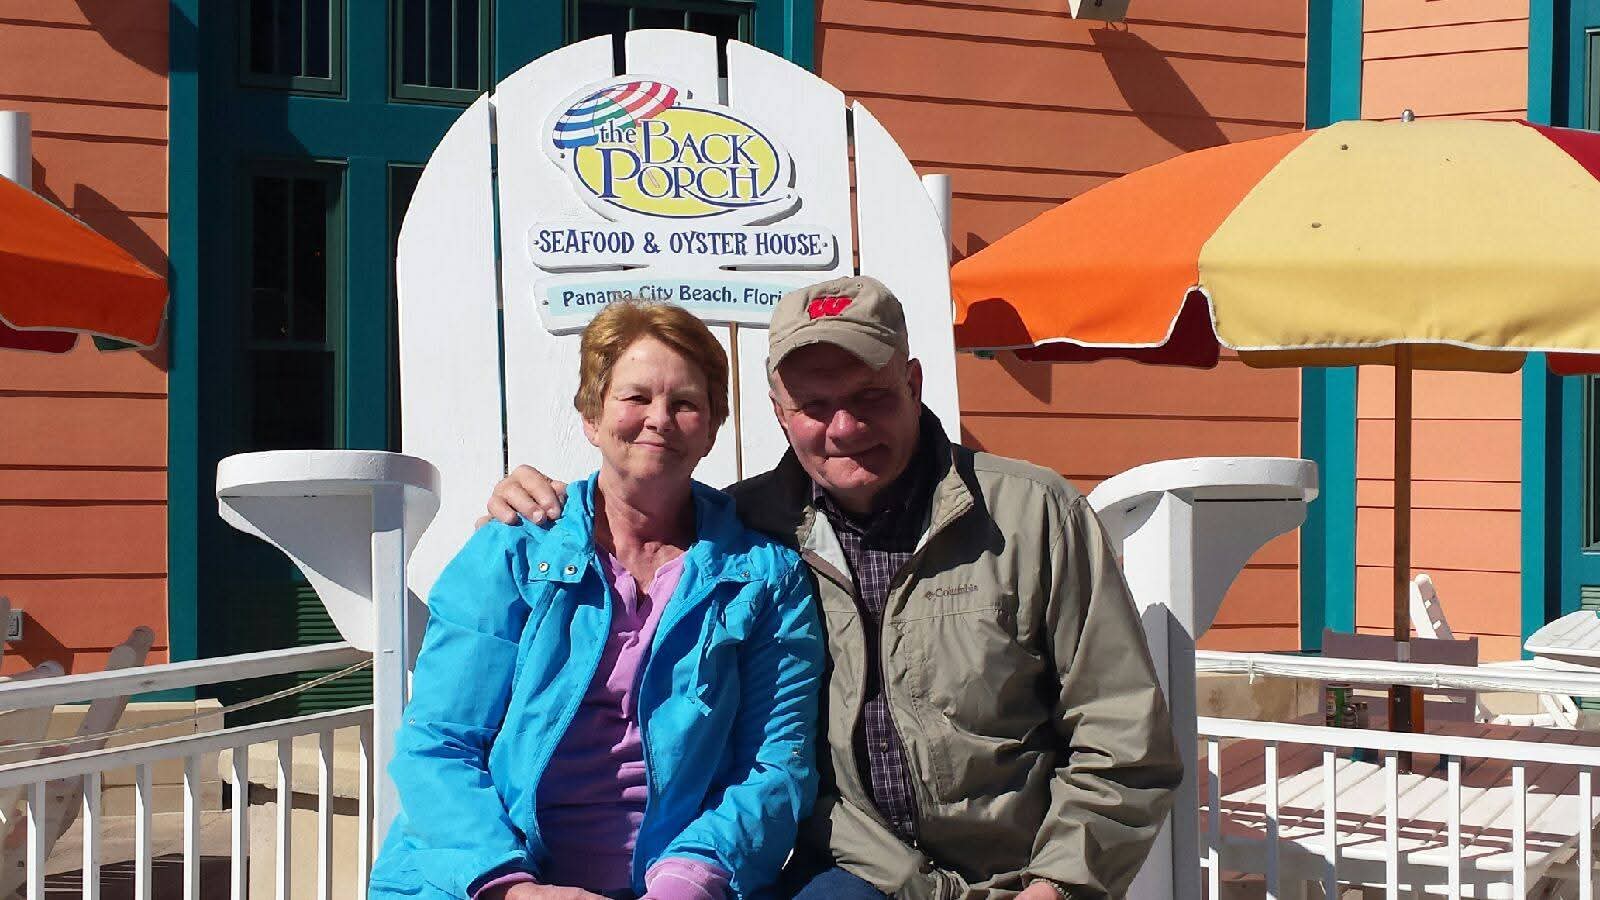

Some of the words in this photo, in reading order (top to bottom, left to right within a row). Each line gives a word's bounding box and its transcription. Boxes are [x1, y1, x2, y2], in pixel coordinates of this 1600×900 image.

[600, 120, 637, 143] the
[641, 120, 757, 165] BACK
[595, 147, 760, 199] PORCH
[539, 229, 635, 254] SEAFOOD
[643, 231, 661, 254] &
[669, 231, 748, 256] OYSTER
[754, 233, 821, 256] HOUSE
[563, 289, 632, 307] Panama
[639, 285, 673, 301] City
[743, 287, 782, 305] Flori
